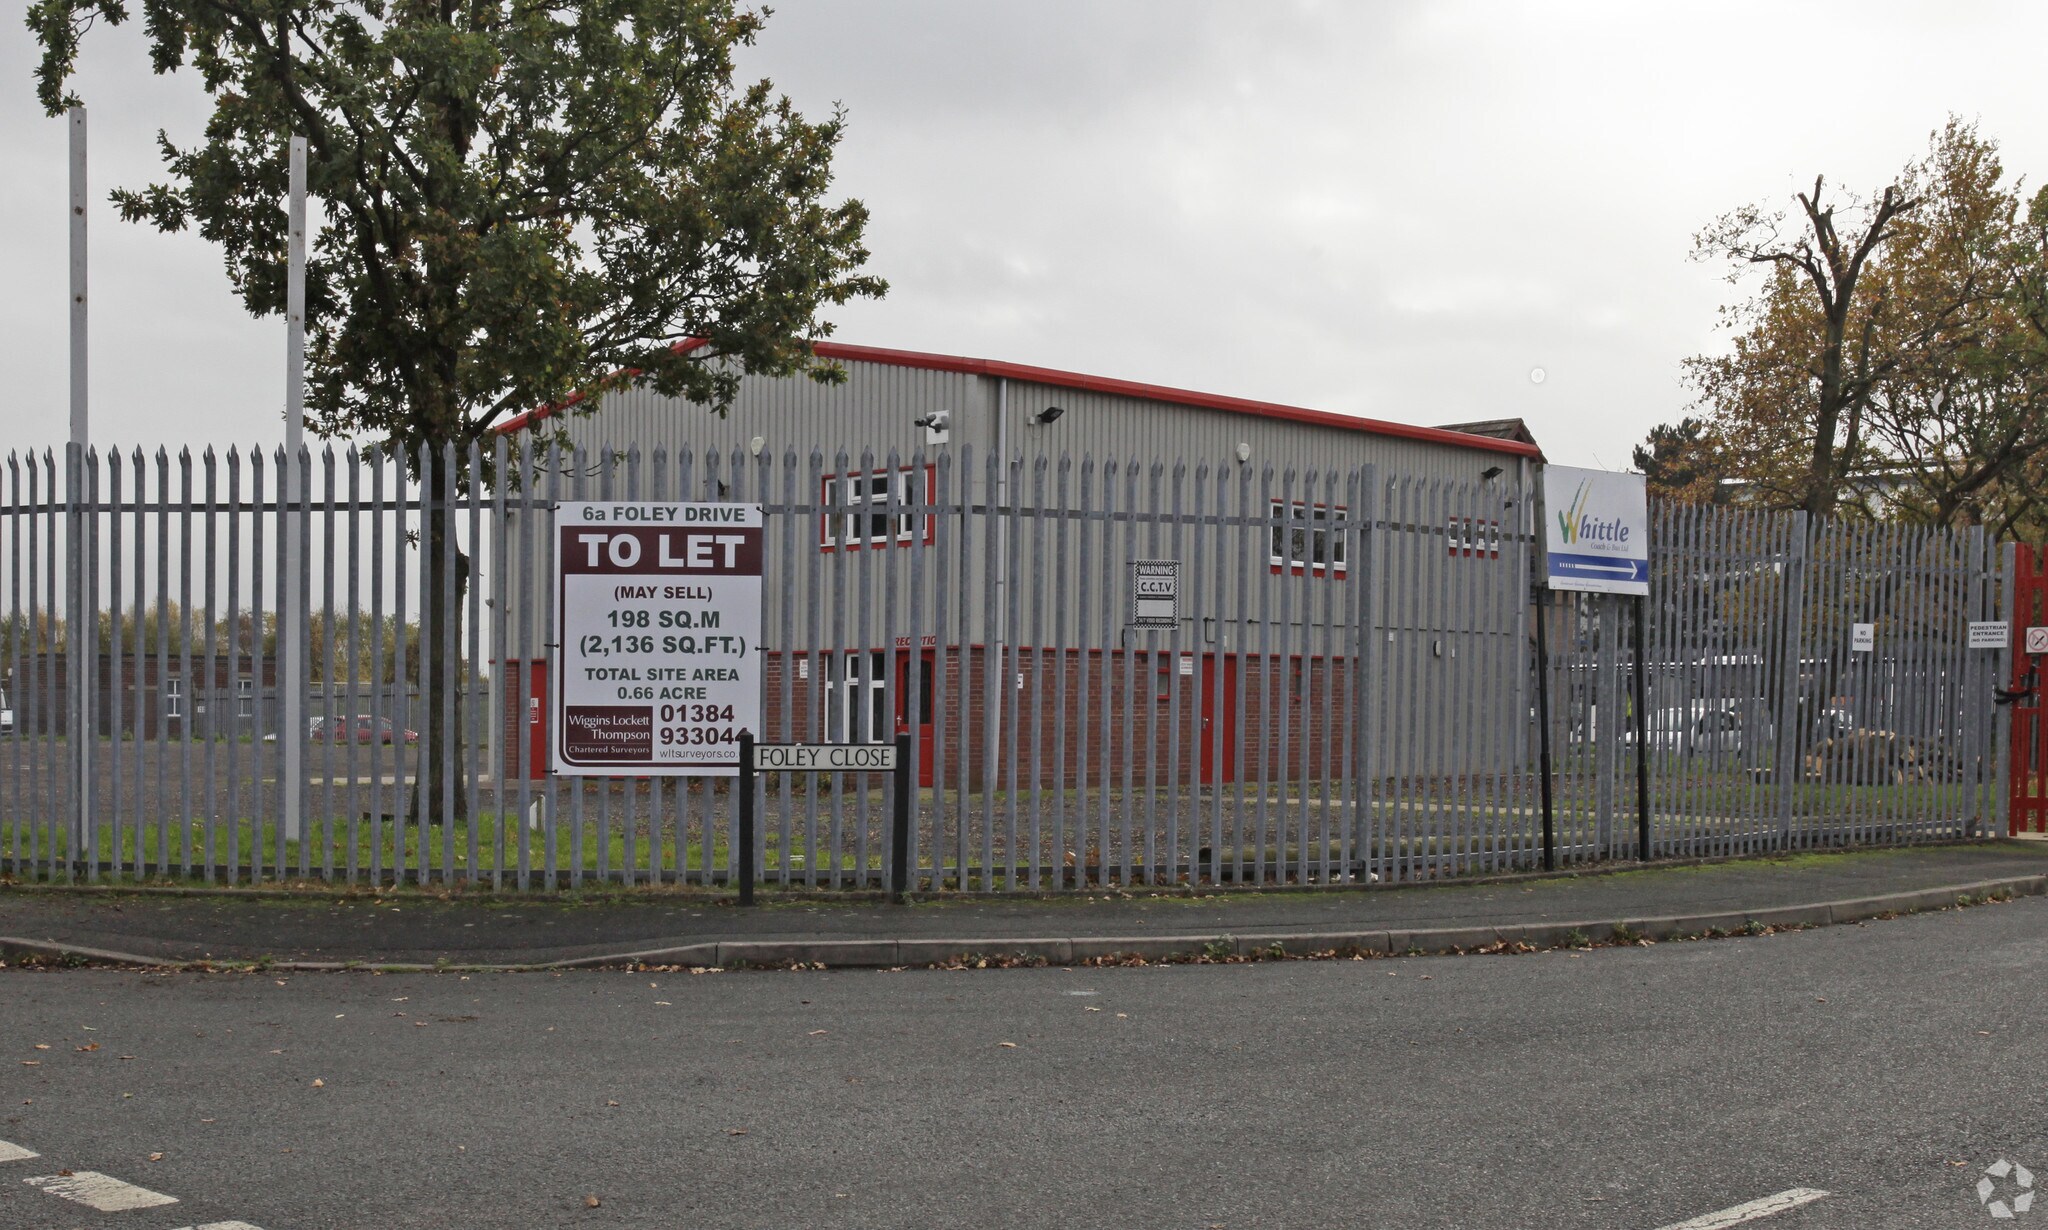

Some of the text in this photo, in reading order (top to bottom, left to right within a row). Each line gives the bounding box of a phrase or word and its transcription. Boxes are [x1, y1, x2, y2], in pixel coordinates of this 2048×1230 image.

[582, 506, 746, 522] 6a FOLEY DRIVE
[1558, 477, 1629, 545] Whittle
[578, 533, 746, 568] TO LET
[1590, 542, 1606, 550] Coach
[1139, 565, 1174, 575] WARNING
[614, 586, 713, 602] (MAY SELL)
[607, 610, 720, 629] 198 SQ.M
[580, 635, 746, 658] (2,136 SQ.FT.)
[895, 635, 937, 647] RECTIO
[585, 668, 740, 681] TOTAL SITE AREA
[617, 687, 707, 700] 0.66 ACRE
[660, 704, 734, 722] 01384
[568, 715, 649, 728] Wiggins Lockett
[591, 729, 650, 742] Thompson
[568, 745, 650, 755] Chartered Surveyors
[660, 749, 740, 760] wltsurveyors.co.
[760, 748, 890, 766] FOLEY CLOSE
